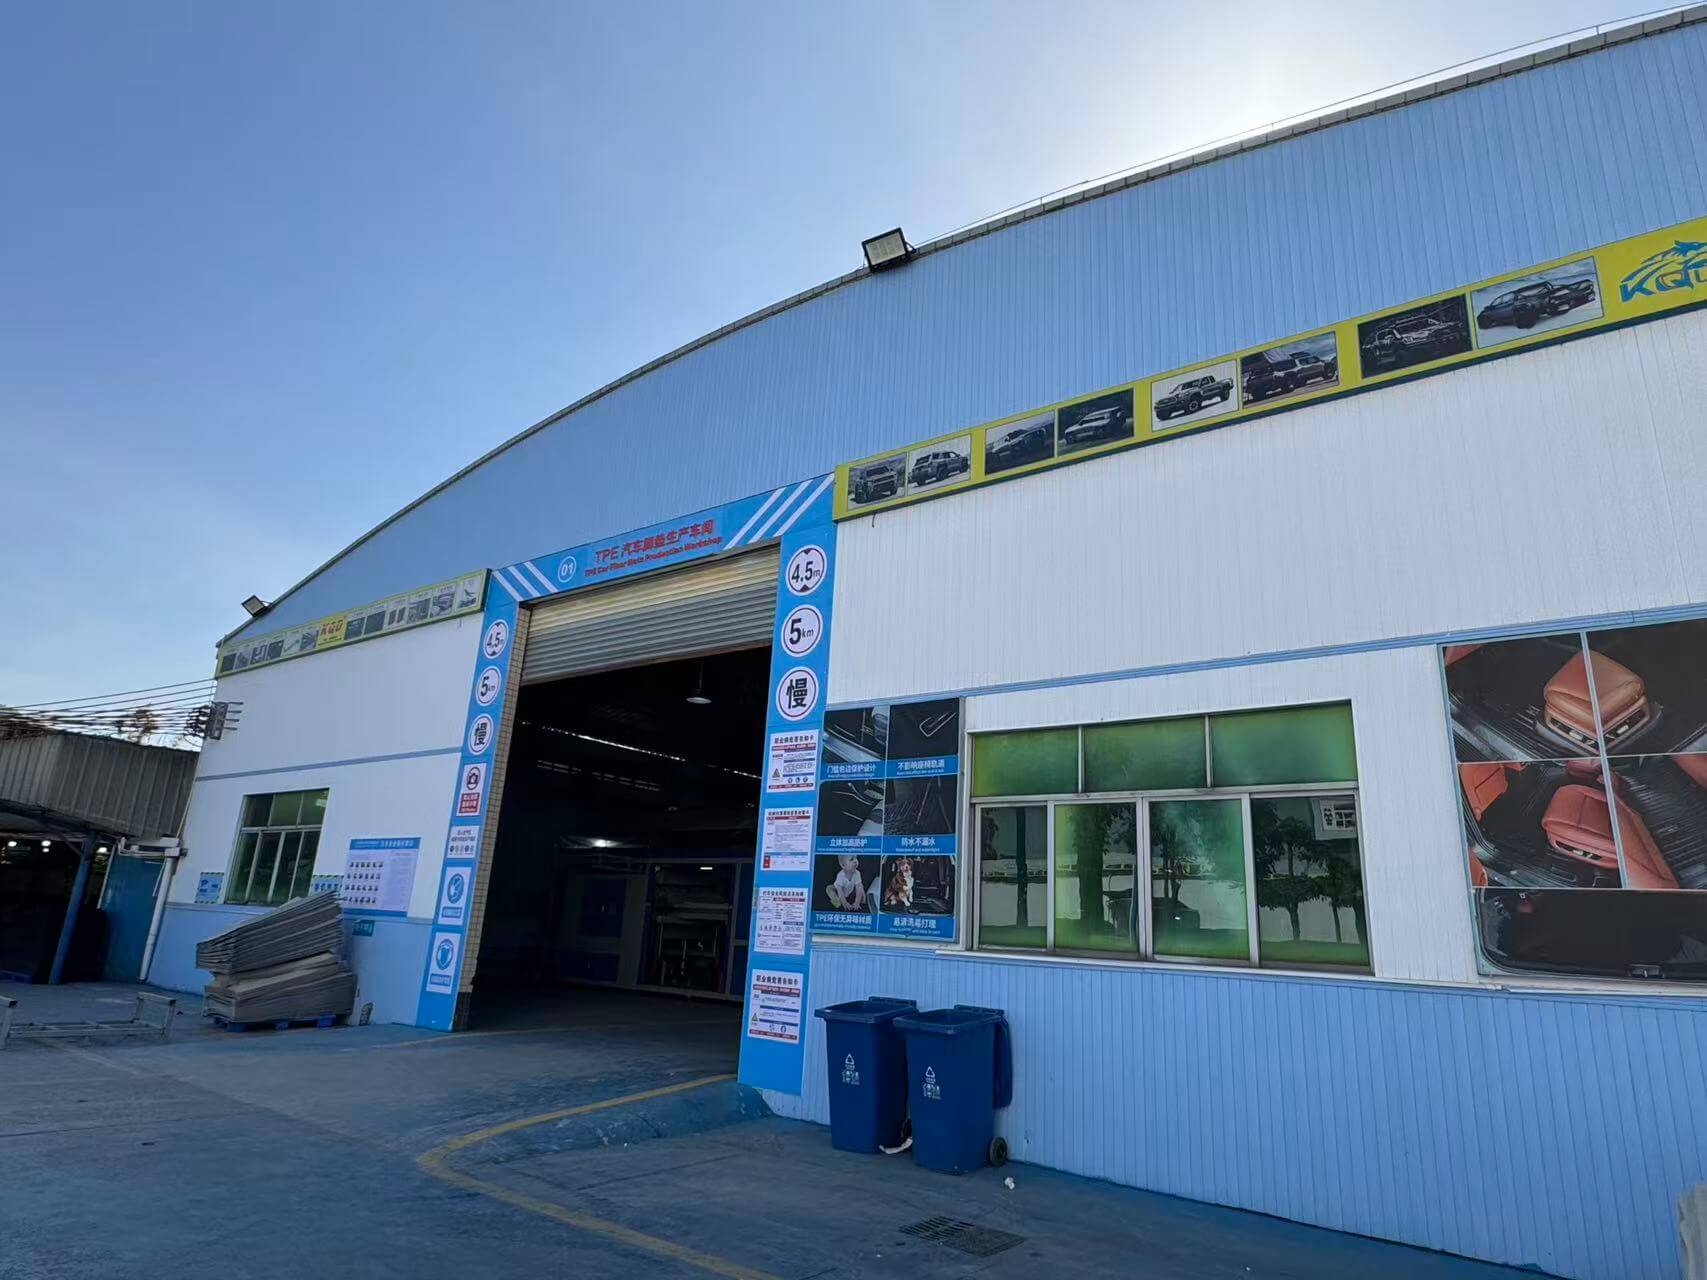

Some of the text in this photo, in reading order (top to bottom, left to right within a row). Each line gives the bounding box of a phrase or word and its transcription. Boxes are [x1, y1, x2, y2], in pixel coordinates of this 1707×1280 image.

[596, 545, 620, 563] TPE
[561, 562, 573, 576] 01
[786, 677, 808, 709] 慢
[473, 721, 489, 747] 慢
